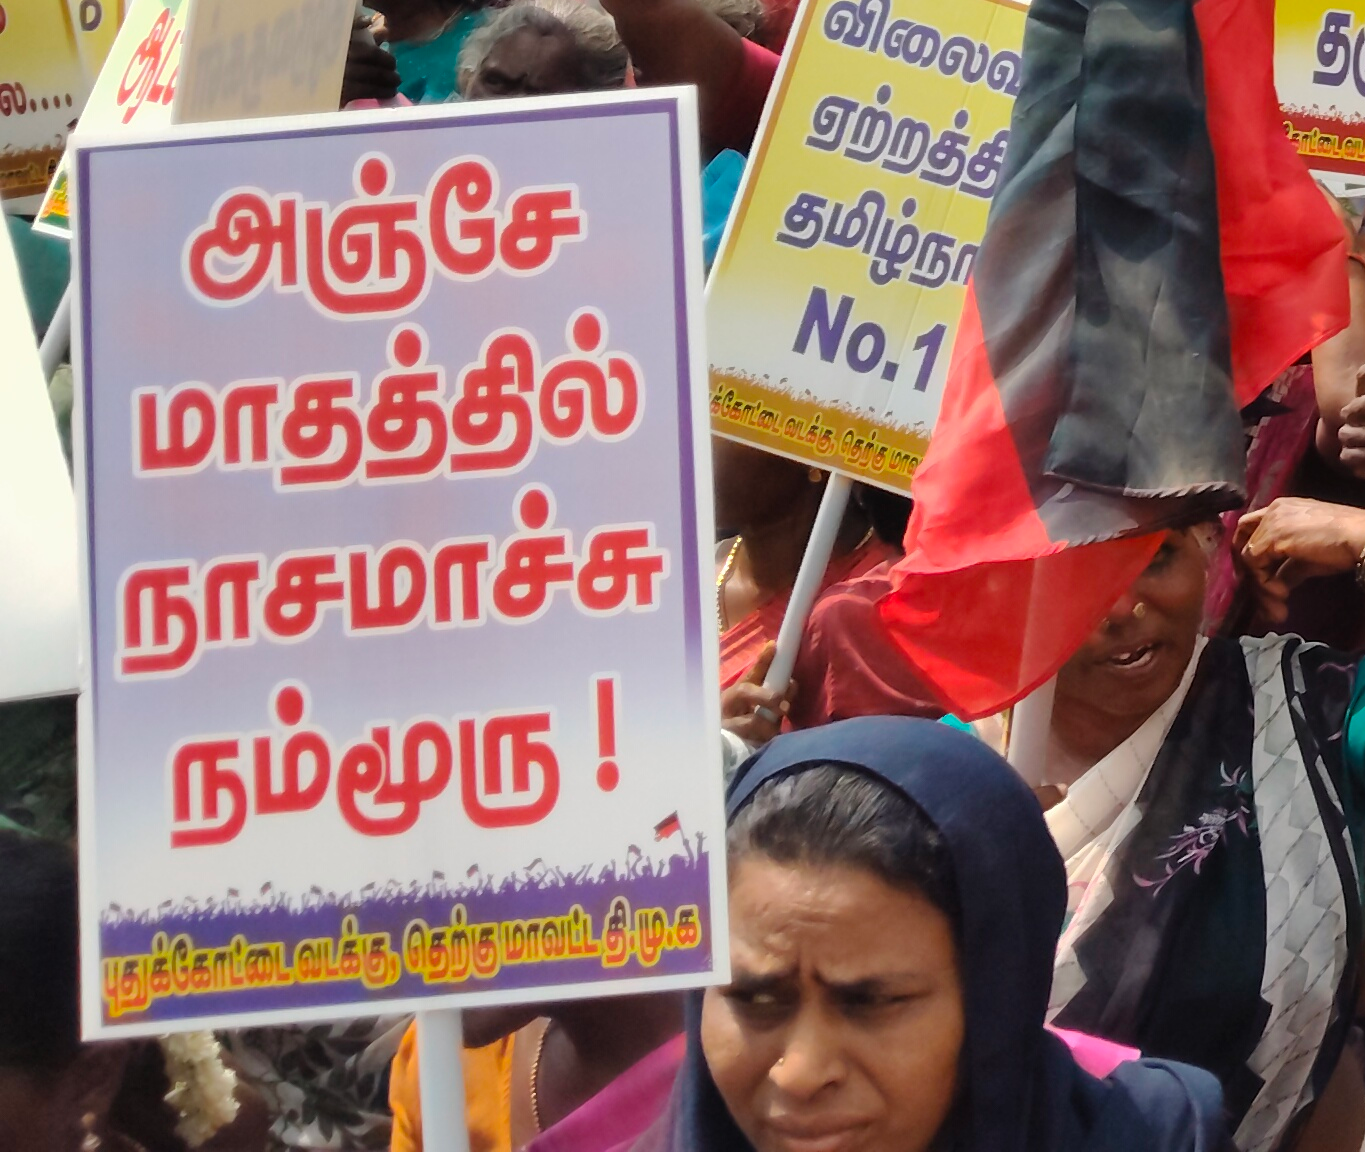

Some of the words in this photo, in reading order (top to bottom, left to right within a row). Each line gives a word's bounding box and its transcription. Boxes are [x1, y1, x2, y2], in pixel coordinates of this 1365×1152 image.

[189, 158, 581, 314] அஞ்சே
[138, 312, 640, 489] மாதத்தில்
[792, 286, 947, 393] No.1
[120, 489, 664, 675] நாசமாச்சு
[171, 686, 561, 849] நம்மூரு
[594, 679, 620, 793] !
[103, 932, 293, 1014] புதுக்கோட்டை
[406, 909, 497, 981] தெற்கு
[502, 912, 599, 963] மாவட்ட
[603, 906, 700, 967] தி.மு.க
